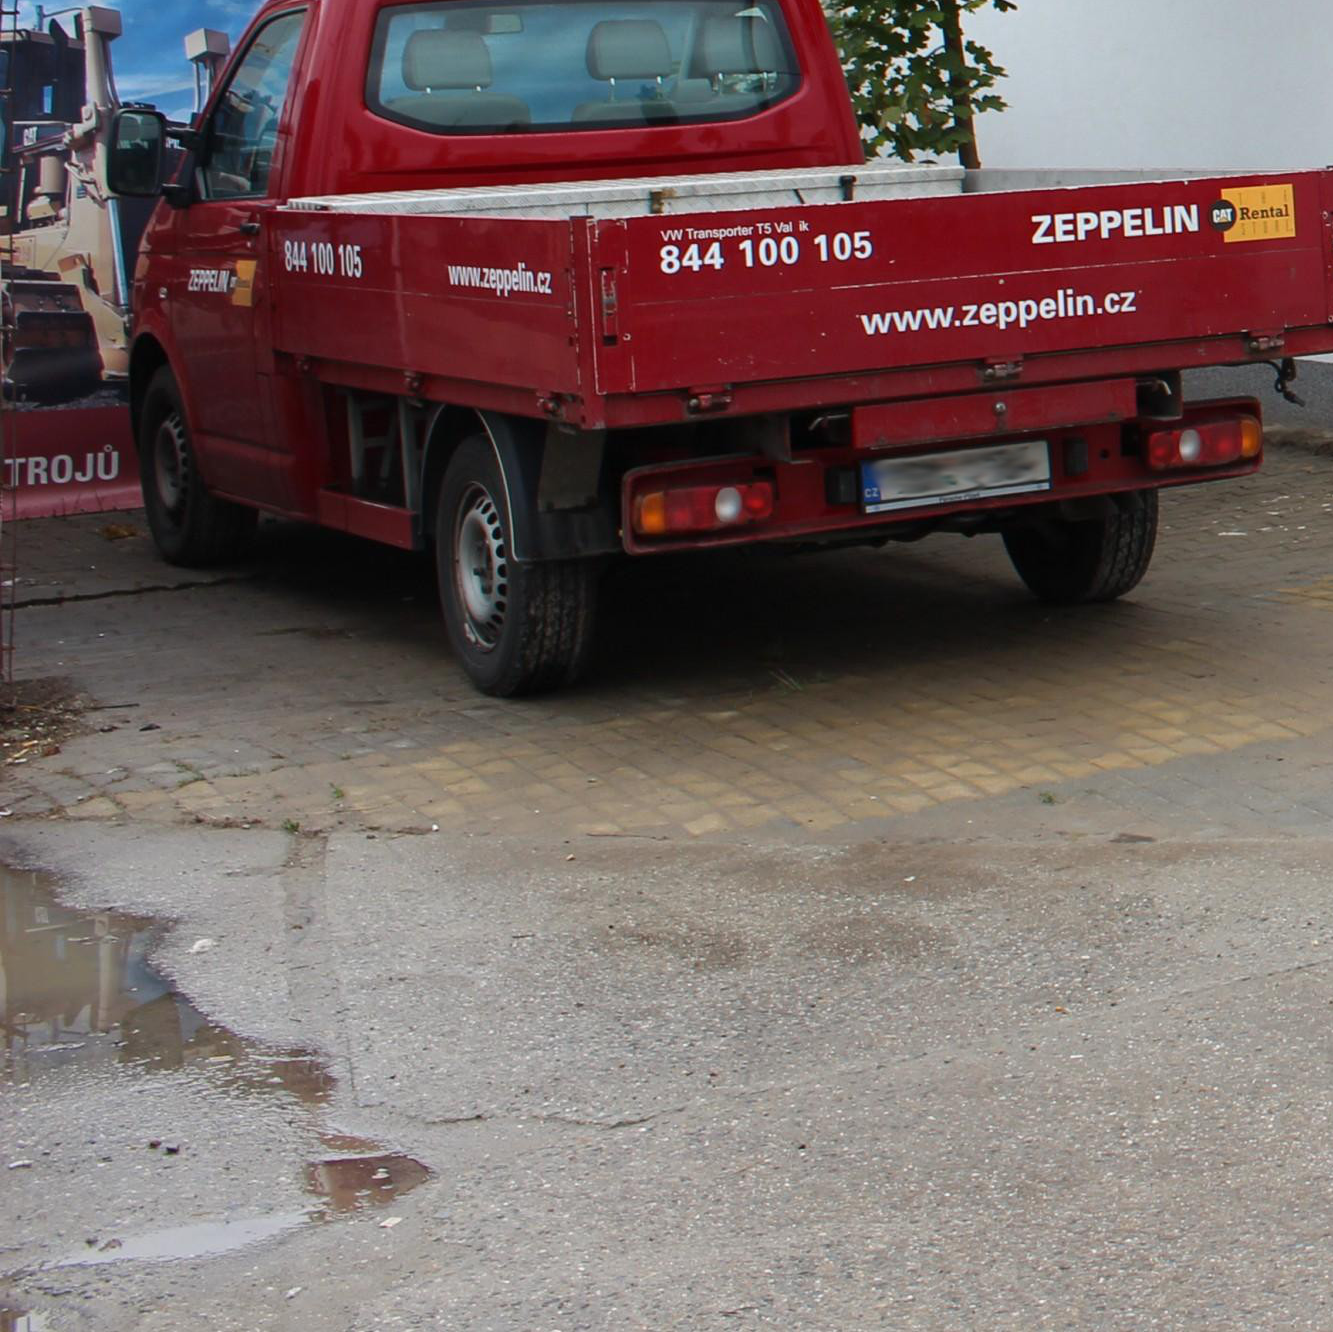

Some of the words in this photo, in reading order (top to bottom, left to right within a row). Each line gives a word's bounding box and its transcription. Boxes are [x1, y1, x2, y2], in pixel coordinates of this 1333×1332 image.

[1031, 204, 1200, 244] ZEPPELIN
[1212, 208, 1233, 223] CAT
[1239, 204, 1289, 221] Rental
[660, 230, 683, 241] VW
[686, 225, 754, 241] Transporter
[755, 223, 772, 235] T5
[284, 240, 308, 273] 844
[311, 242, 334, 275] 100
[338, 244, 362, 278] 105
[659, 242, 724, 274] 844
[738, 236, 799, 268] 100
[813, 231, 873, 262] 105
[188, 269, 230, 293] ZEPPELIN
[448, 261, 552, 297] www.zeppelin.cz
[860, 288, 1137, 336] www.zeppelin.cz
[864, 487, 880, 499] CZ
